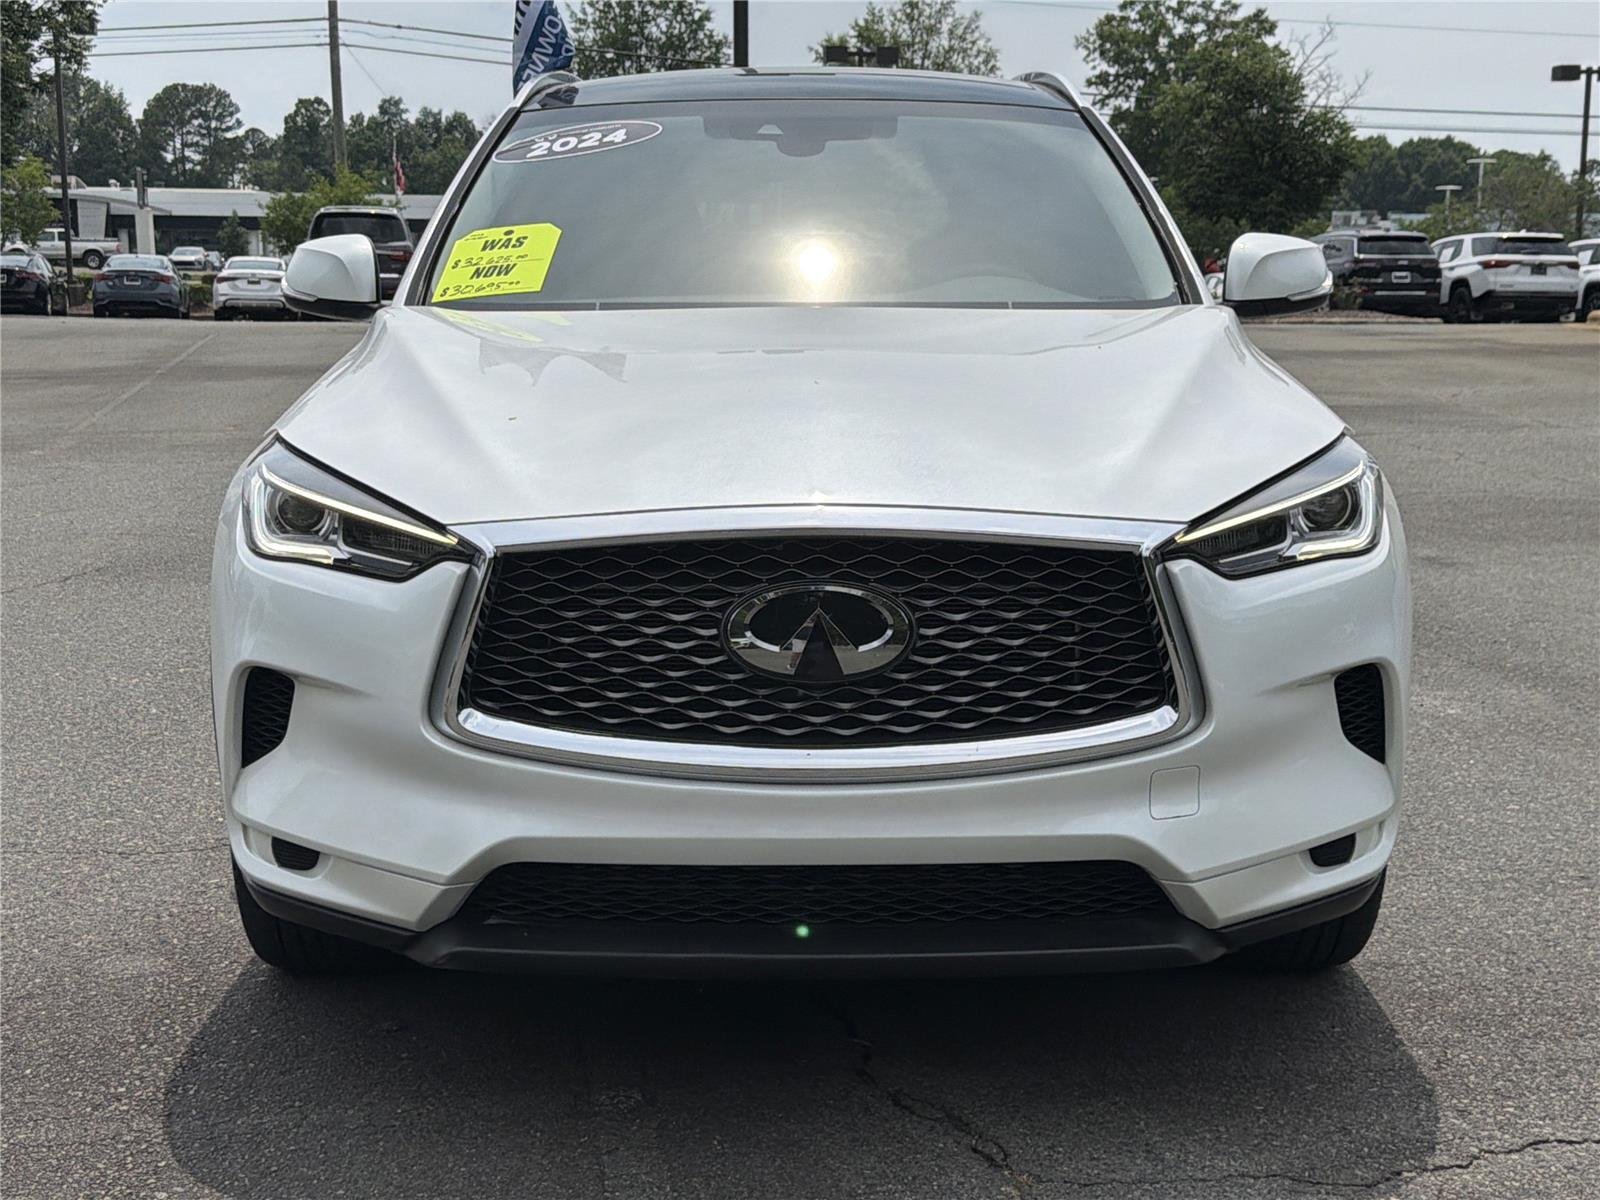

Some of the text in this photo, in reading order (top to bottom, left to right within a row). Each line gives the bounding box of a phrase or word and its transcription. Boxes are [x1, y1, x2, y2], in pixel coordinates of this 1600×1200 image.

[526, 128, 627, 158] 2024
[480, 236, 528, 252] WAS
[469, 263, 518, 280] NOW
